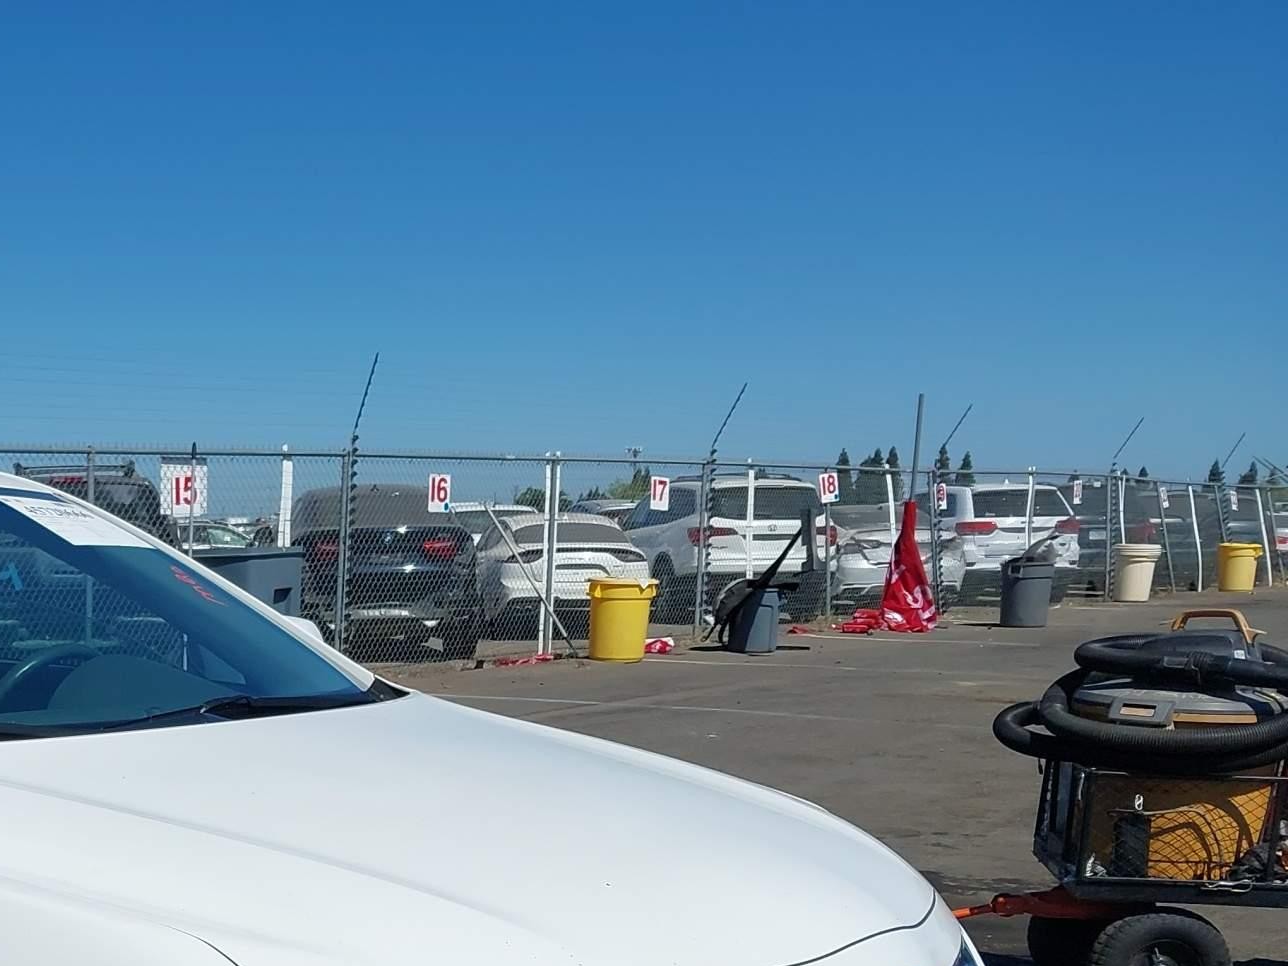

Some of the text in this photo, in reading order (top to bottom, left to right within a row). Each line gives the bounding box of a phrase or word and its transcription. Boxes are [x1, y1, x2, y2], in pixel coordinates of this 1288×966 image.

[174, 476, 198, 506] 15
[431, 477, 448, 503] 16
[653, 479, 668, 502] 17
[822, 474, 836, 496] 18
